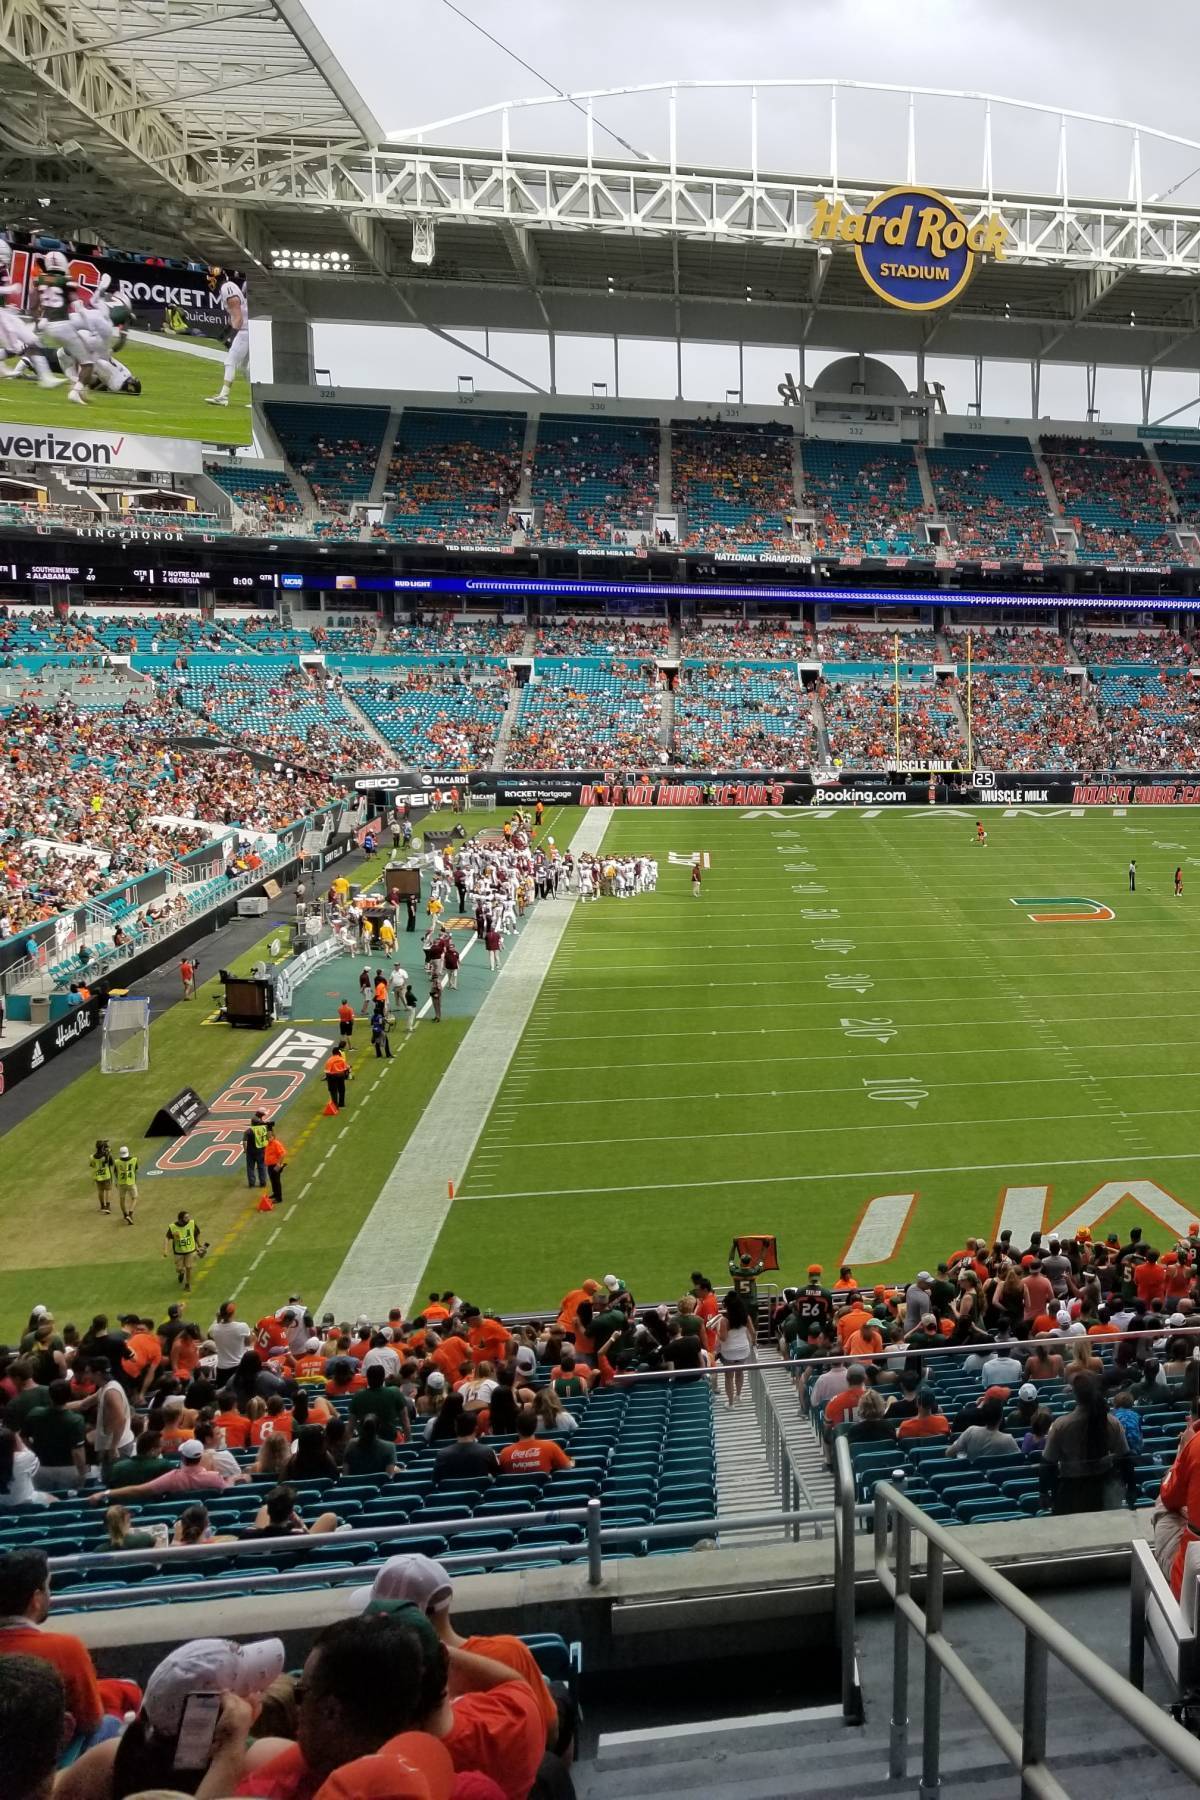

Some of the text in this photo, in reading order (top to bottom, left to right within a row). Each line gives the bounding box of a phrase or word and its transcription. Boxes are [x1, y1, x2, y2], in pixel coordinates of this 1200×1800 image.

[811, 198, 1010, 261] Hard Rock
[880, 262, 950, 281] STADIUM
[119, 279, 206, 308] ROCKET
[0, 433, 111, 464] verizon
[77, 528, 115, 538] RING
[130, 531, 184, 541] HONOR
[714, 552, 812, 564] NATIONAL CHAMPIONS
[233, 577, 253, 585] 8:00
[887, 760, 954, 771] MUSCLE MILK
[355, 777, 399, 789] GEICO
[434, 775, 468, 784] BACARDÍ
[976, 773, 991, 785] 25
[504, 790, 571, 799] ROCKET Mortgage
[816, 788, 906, 803] Booking.com
[982, 789, 1047, 802] MUSCLE MILK
[1072, 786, 1131, 804] MIAMI
[265, 1031, 335, 1070] ACC
[31, 1054, 45, 1068] adidas
[1123, 1266, 1132, 1282] 5
[740, 1281, 750, 1293] 5
[802, 1303, 820, 1316] 26
[258, 1328, 271, 1348] 15
[260, 1422, 274, 1441] 8
[511, 1448, 541, 1459] Coca-Cola
